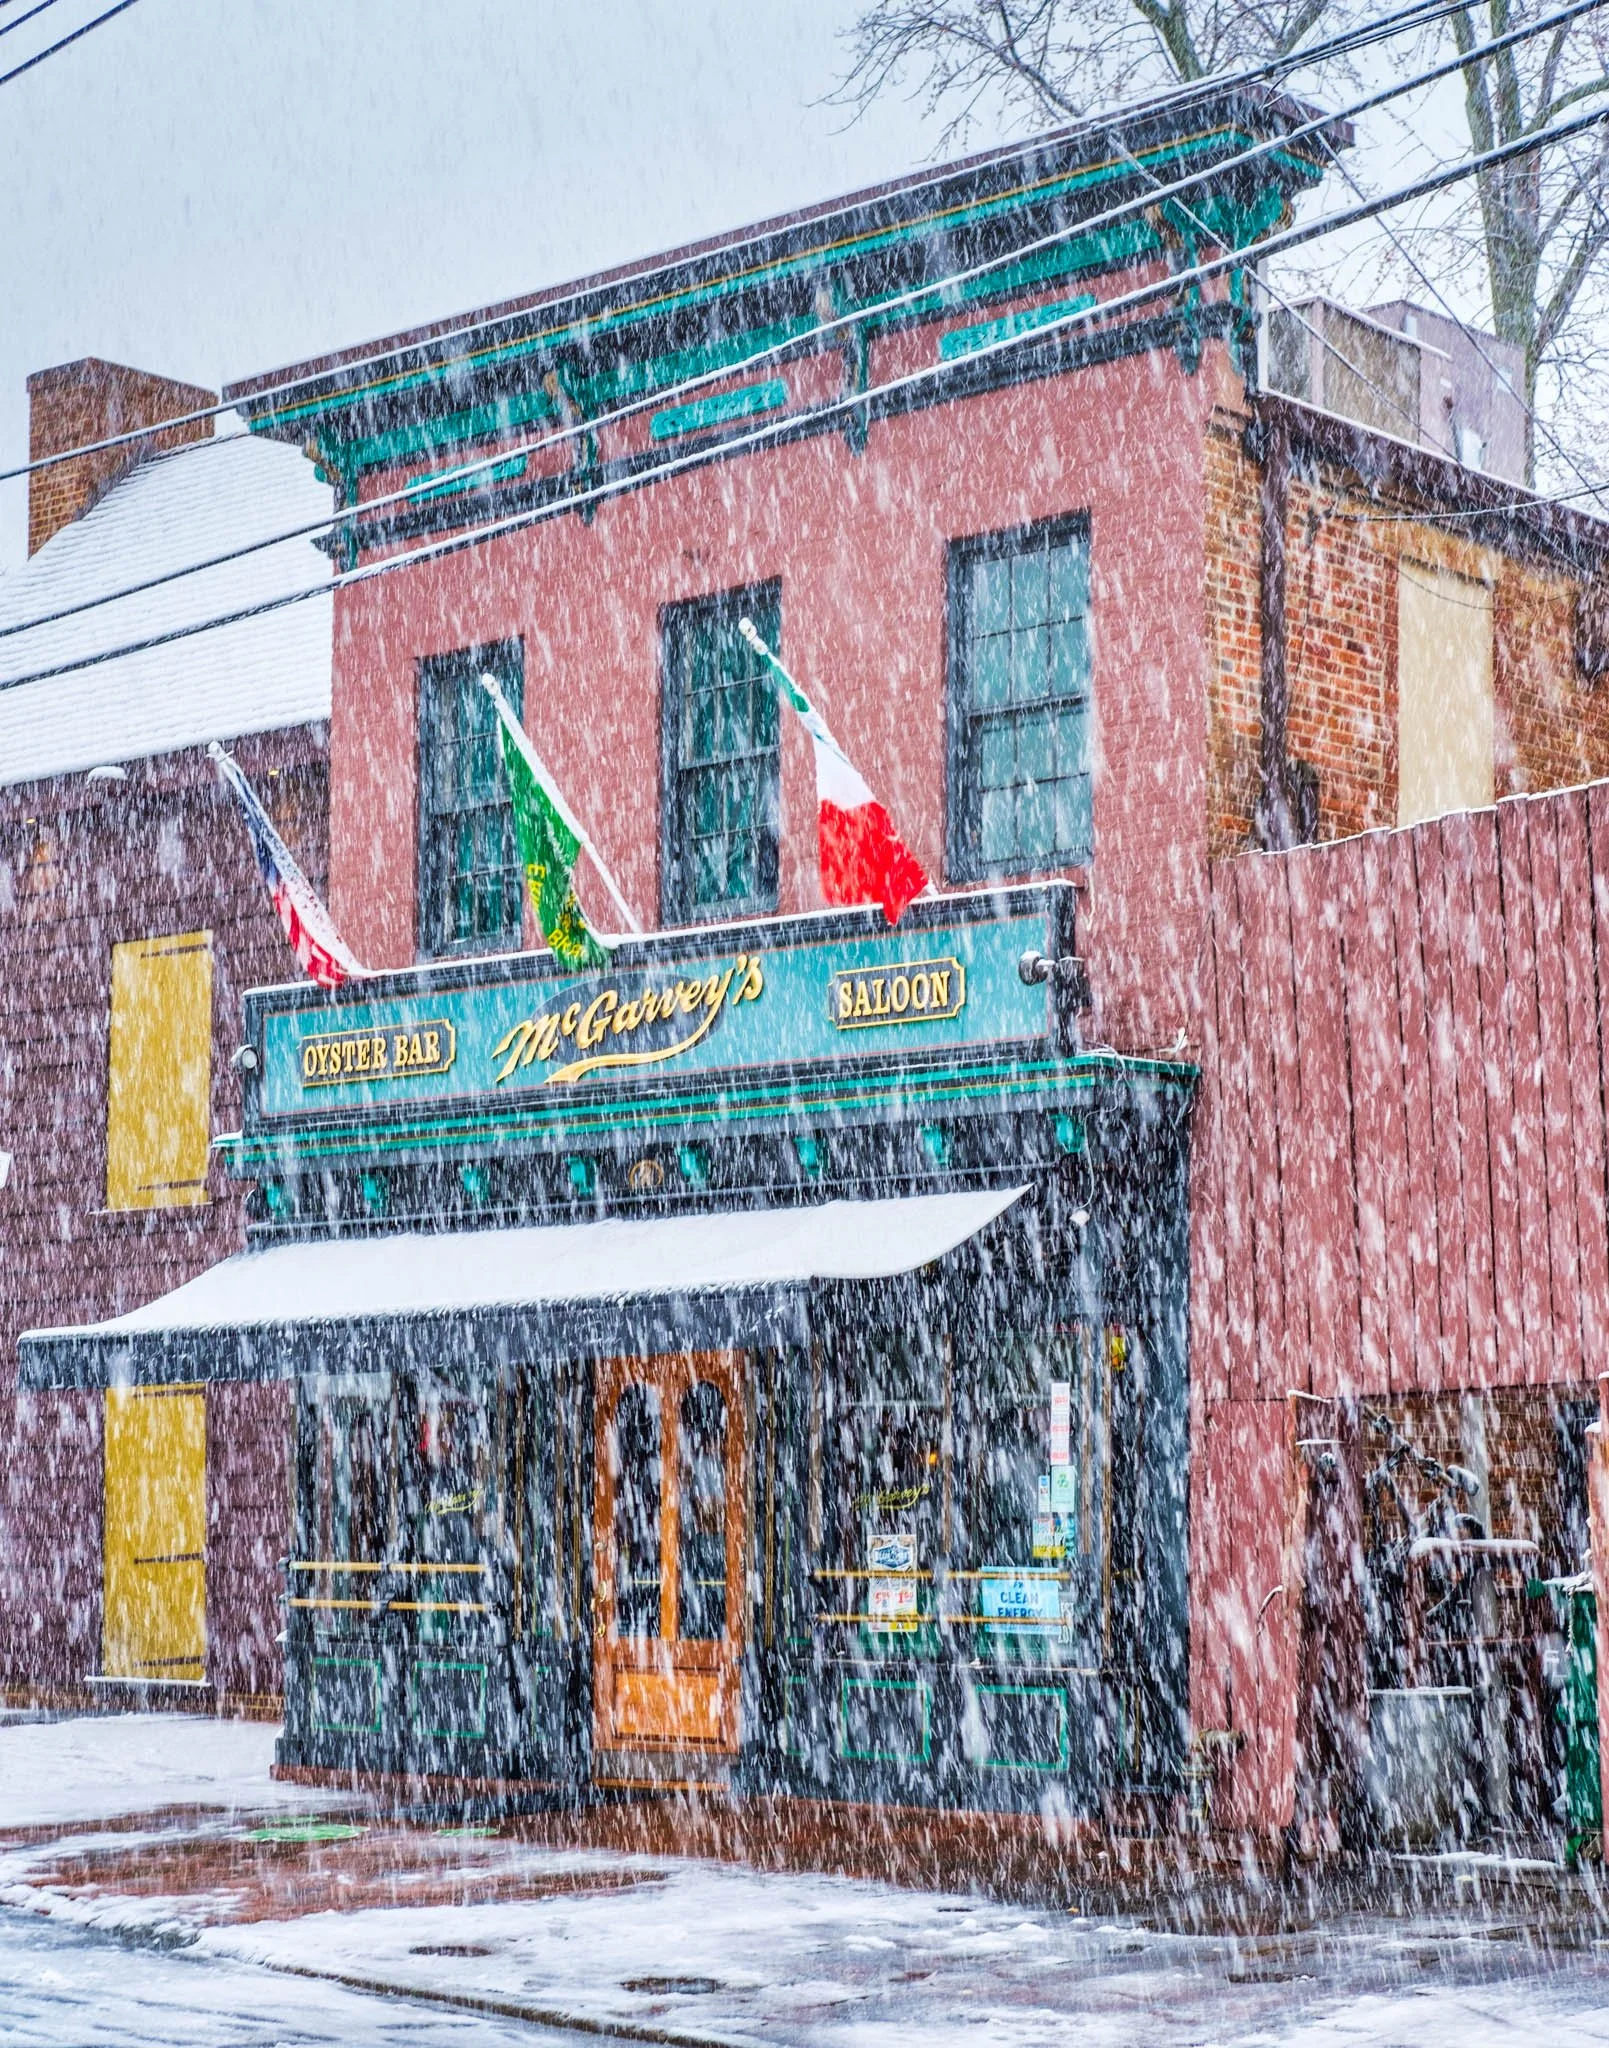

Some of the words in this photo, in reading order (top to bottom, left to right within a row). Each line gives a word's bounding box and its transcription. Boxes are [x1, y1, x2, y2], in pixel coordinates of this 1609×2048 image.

[838, 970, 951, 1019] SALOON
[491, 954, 764, 1083] McGarvey's
[303, 1037, 388, 1077] OYSTER
[393, 1031, 441, 1067] BAR
[1000, 1591, 1040, 1605] CLEAN
